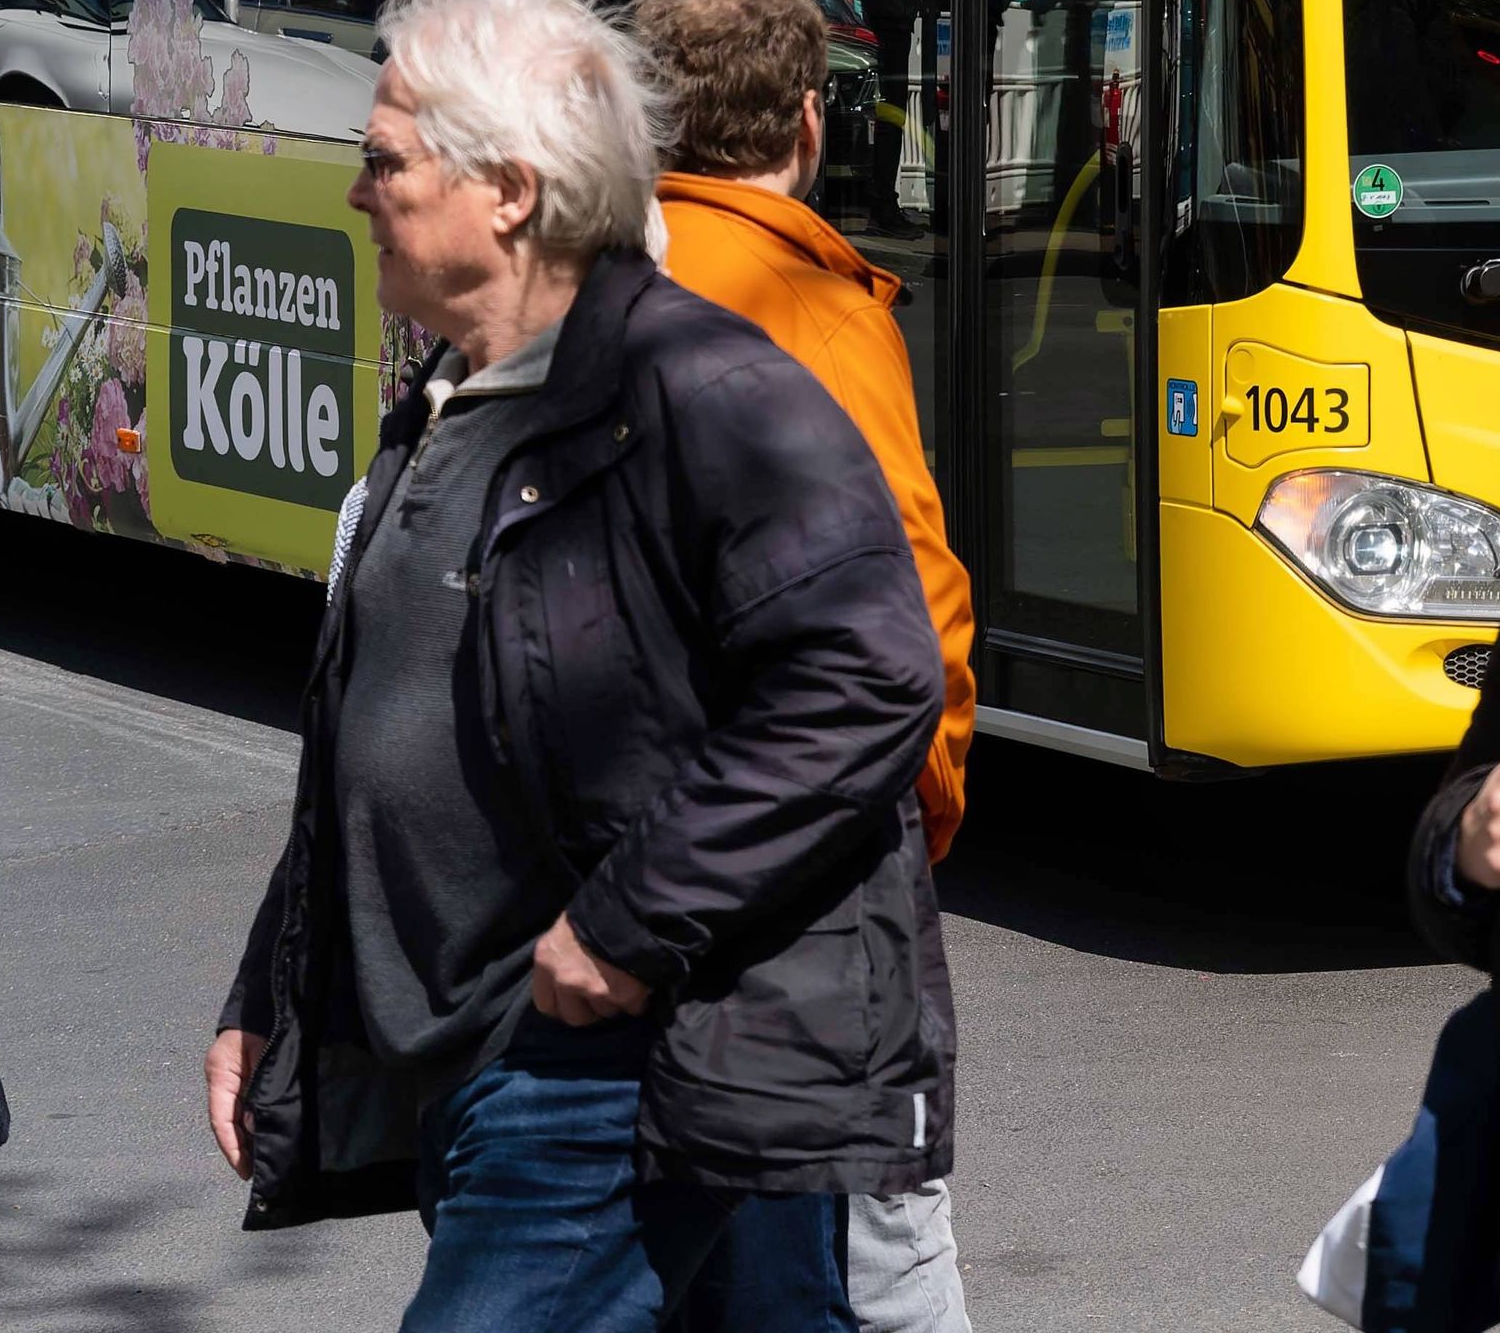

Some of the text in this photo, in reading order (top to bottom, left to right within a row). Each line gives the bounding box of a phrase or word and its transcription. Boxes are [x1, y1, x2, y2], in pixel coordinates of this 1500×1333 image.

[1372, 168, 1385, 192] 4
[183, 239, 341, 332] Pflanzen
[182, 335, 340, 478] Kölle
[1245, 386, 1350, 434] 1043
